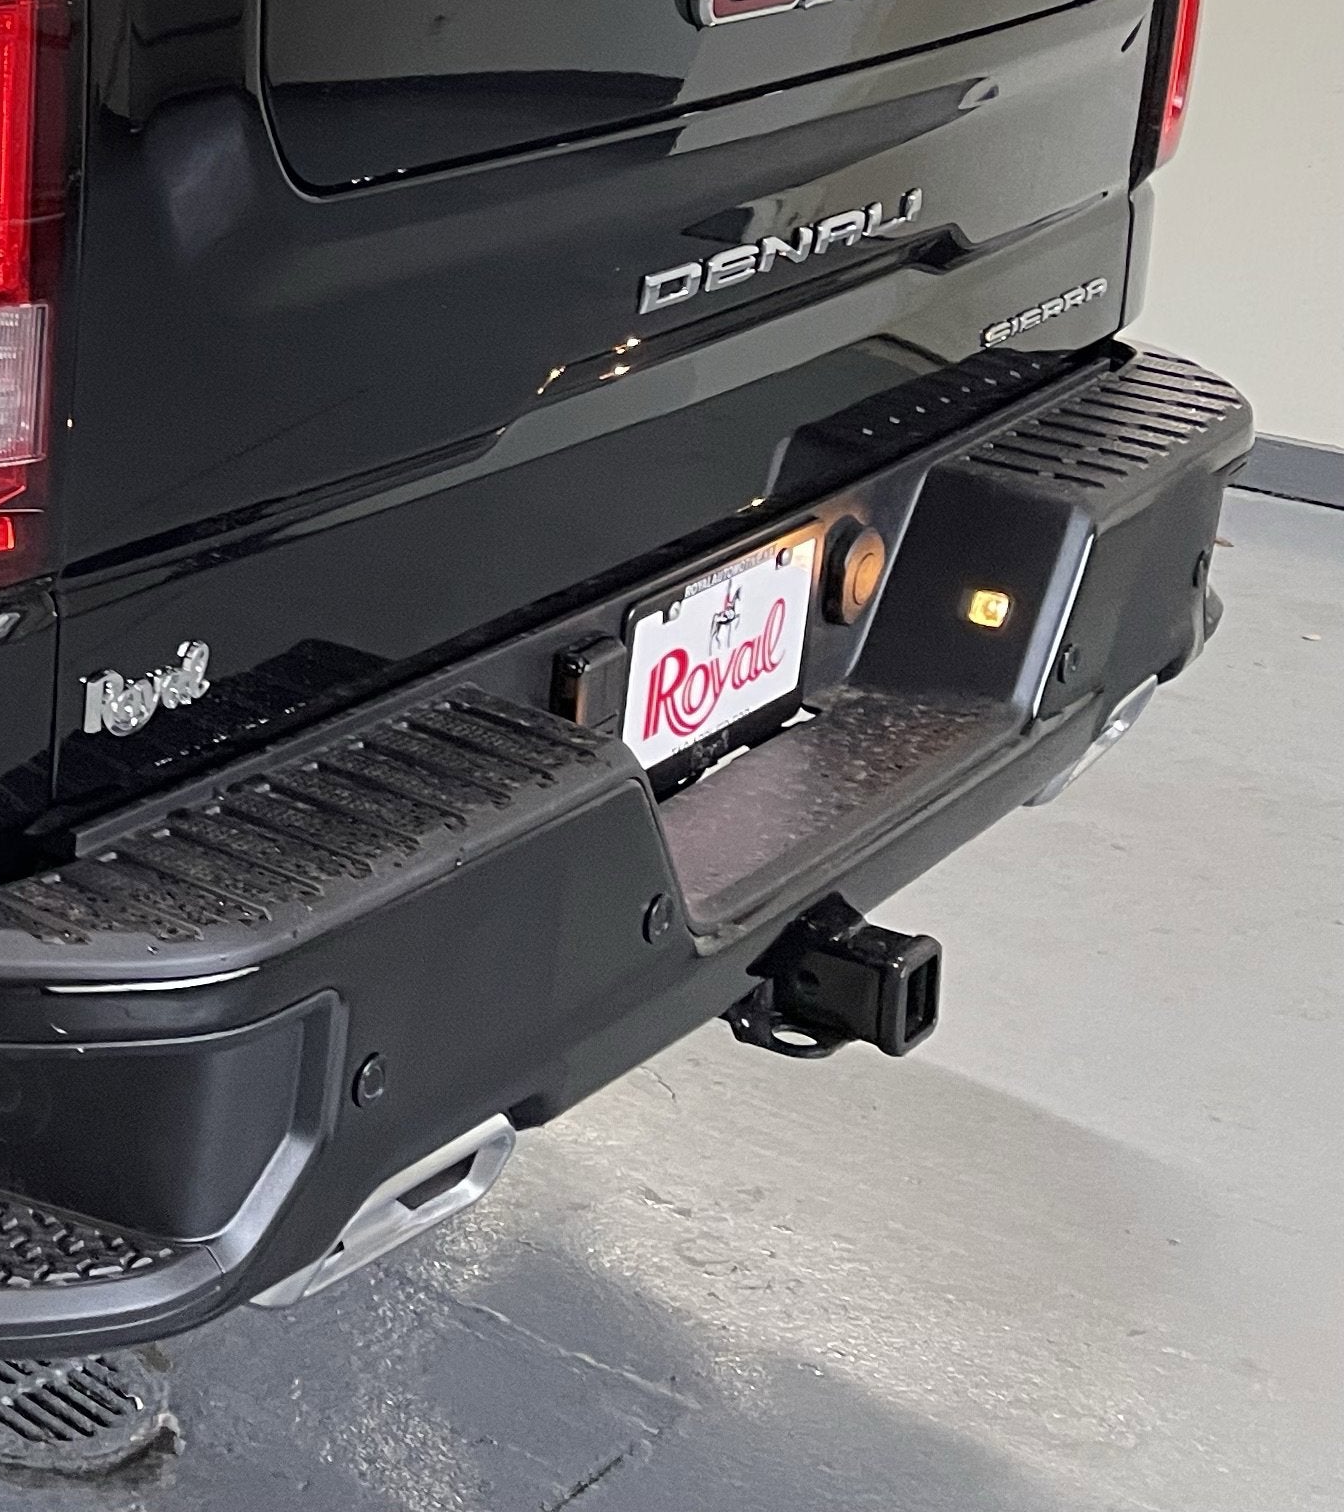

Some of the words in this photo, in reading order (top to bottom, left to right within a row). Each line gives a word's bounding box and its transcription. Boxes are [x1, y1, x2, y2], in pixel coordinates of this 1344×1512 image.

[638, 187, 923, 315] DENALI
[980, 276, 1108, 349] SIERRA
[642, 597, 787, 742] Royal
